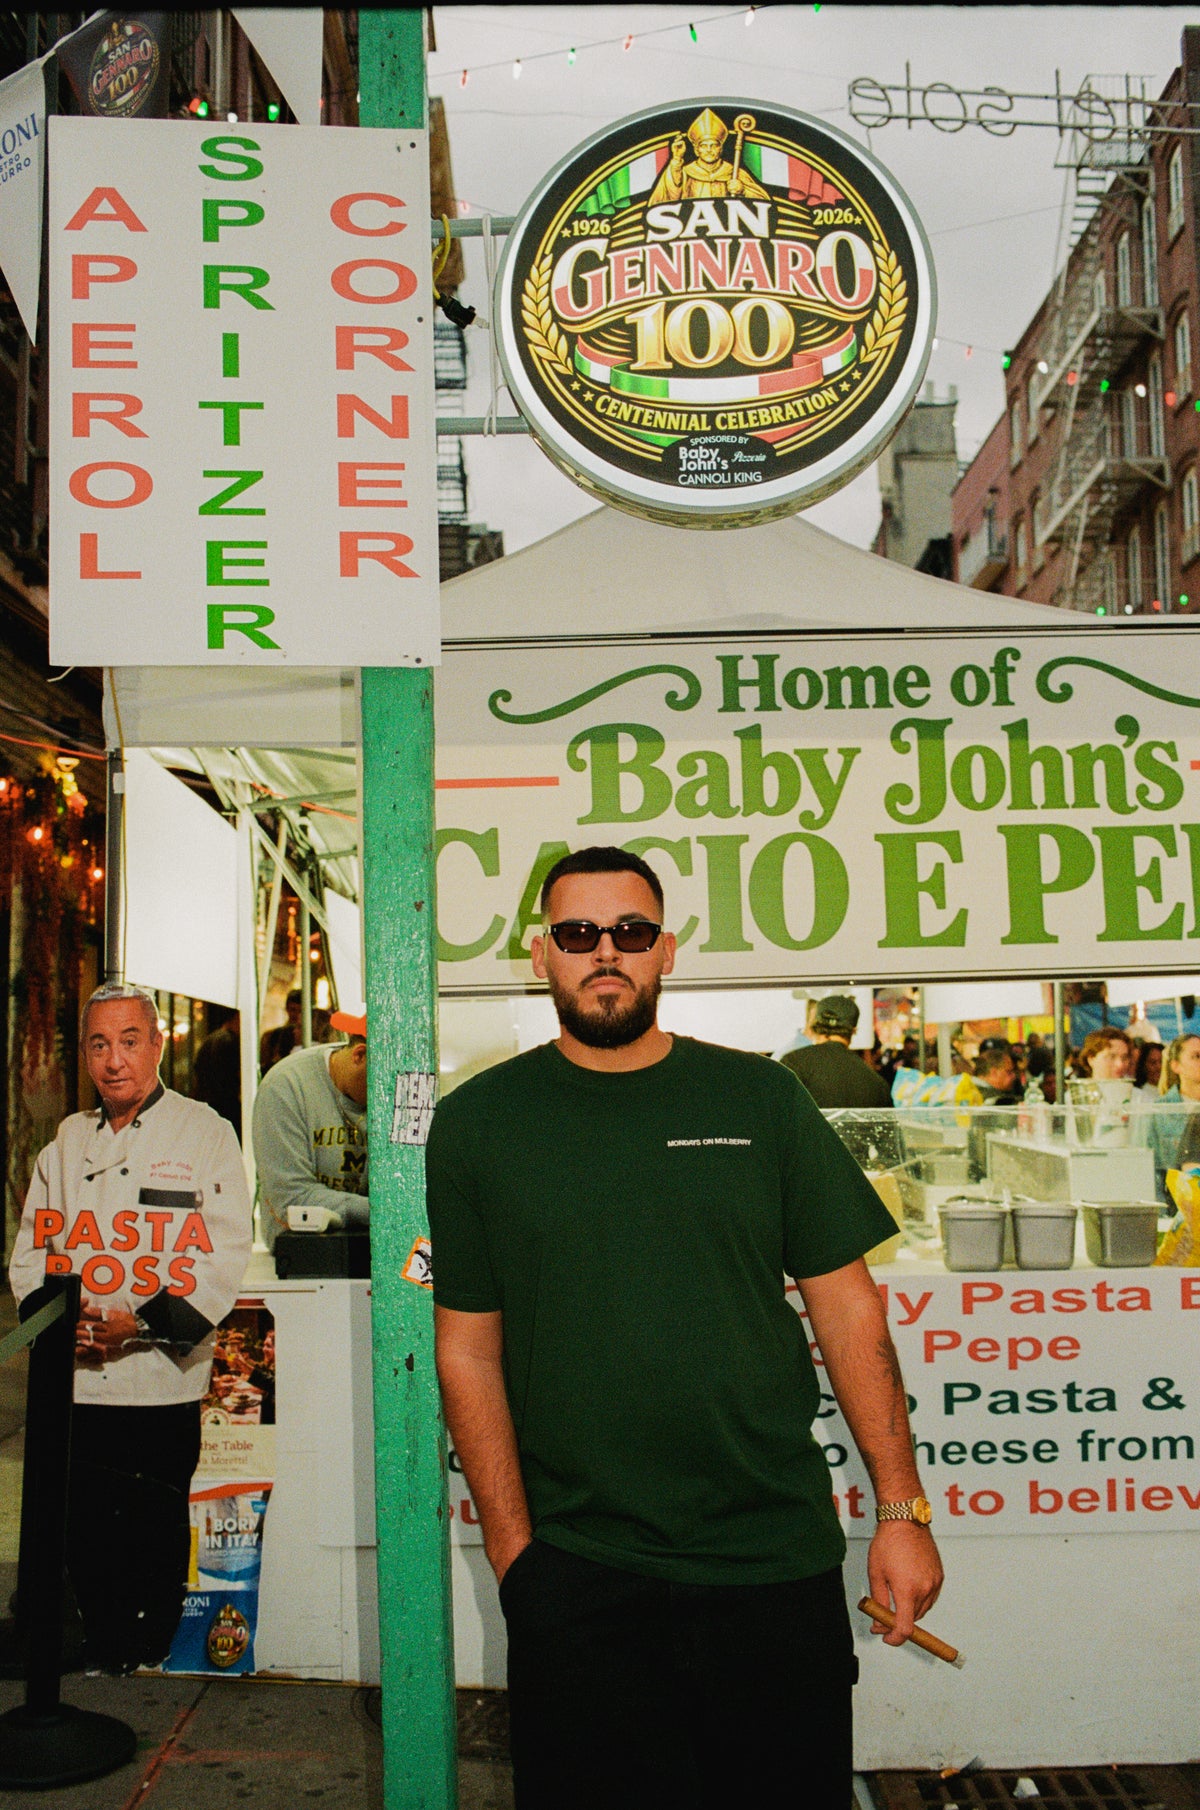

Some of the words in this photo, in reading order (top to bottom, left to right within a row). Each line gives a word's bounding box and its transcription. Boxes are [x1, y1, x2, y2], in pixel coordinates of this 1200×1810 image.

[93, 39, 153, 95] GENNARO
[108, 40, 131, 64] SAN
[107, 66, 139, 101] 100
[0, 113, 39, 159] ONI
[0, 157, 31, 186] URRO
[572, 218, 611, 237] 1926
[646, 199, 772, 243] SAN
[812, 208, 854, 226] 2026
[551, 230, 877, 322] GENNARO
[624, 296, 795, 371] 100
[64, 187, 154, 580] APEROL
[198, 136, 283, 650] SPRITZER
[330, 192, 422, 579] CORNER
[595, 394, 711, 432] CENTENNIAL
[715, 386, 840, 431] CELEBRATION
[679, 446, 720, 461] Baby
[690, 435, 737, 446] SPONSORED
[738, 435, 749, 445] BY
[678, 472, 731, 486] CANNOLI
[733, 471, 763, 483] KING
[679, 457, 729, 472] John's
[716, 652, 931, 713] Home
[950, 646, 1021, 708] of
[566, 721, 862, 831] Baby
[884, 714, 1184, 826] John's
[874, 829, 969, 949] E
[997, 823, 1200, 945] PE
[702, 1138, 714, 1146] ON
[33, 1208, 214, 1253] PASTA
[880, 1284, 934, 1325] ly
[962, 1280, 1152, 1314] Pasta
[924, 1330, 1081, 1371] Pepe
[944, 1381, 1117, 1416] Pasta
[1142, 1376, 1187, 1412] &
[222, 1440, 254, 1451] Table
[912, 1429, 1060, 1466] heese
[1077, 1429, 1195, 1463] from
[944, 1482, 1005, 1517] to
[206, 1535, 222, 1549] IN
[214, 1517, 259, 1533] BORN
